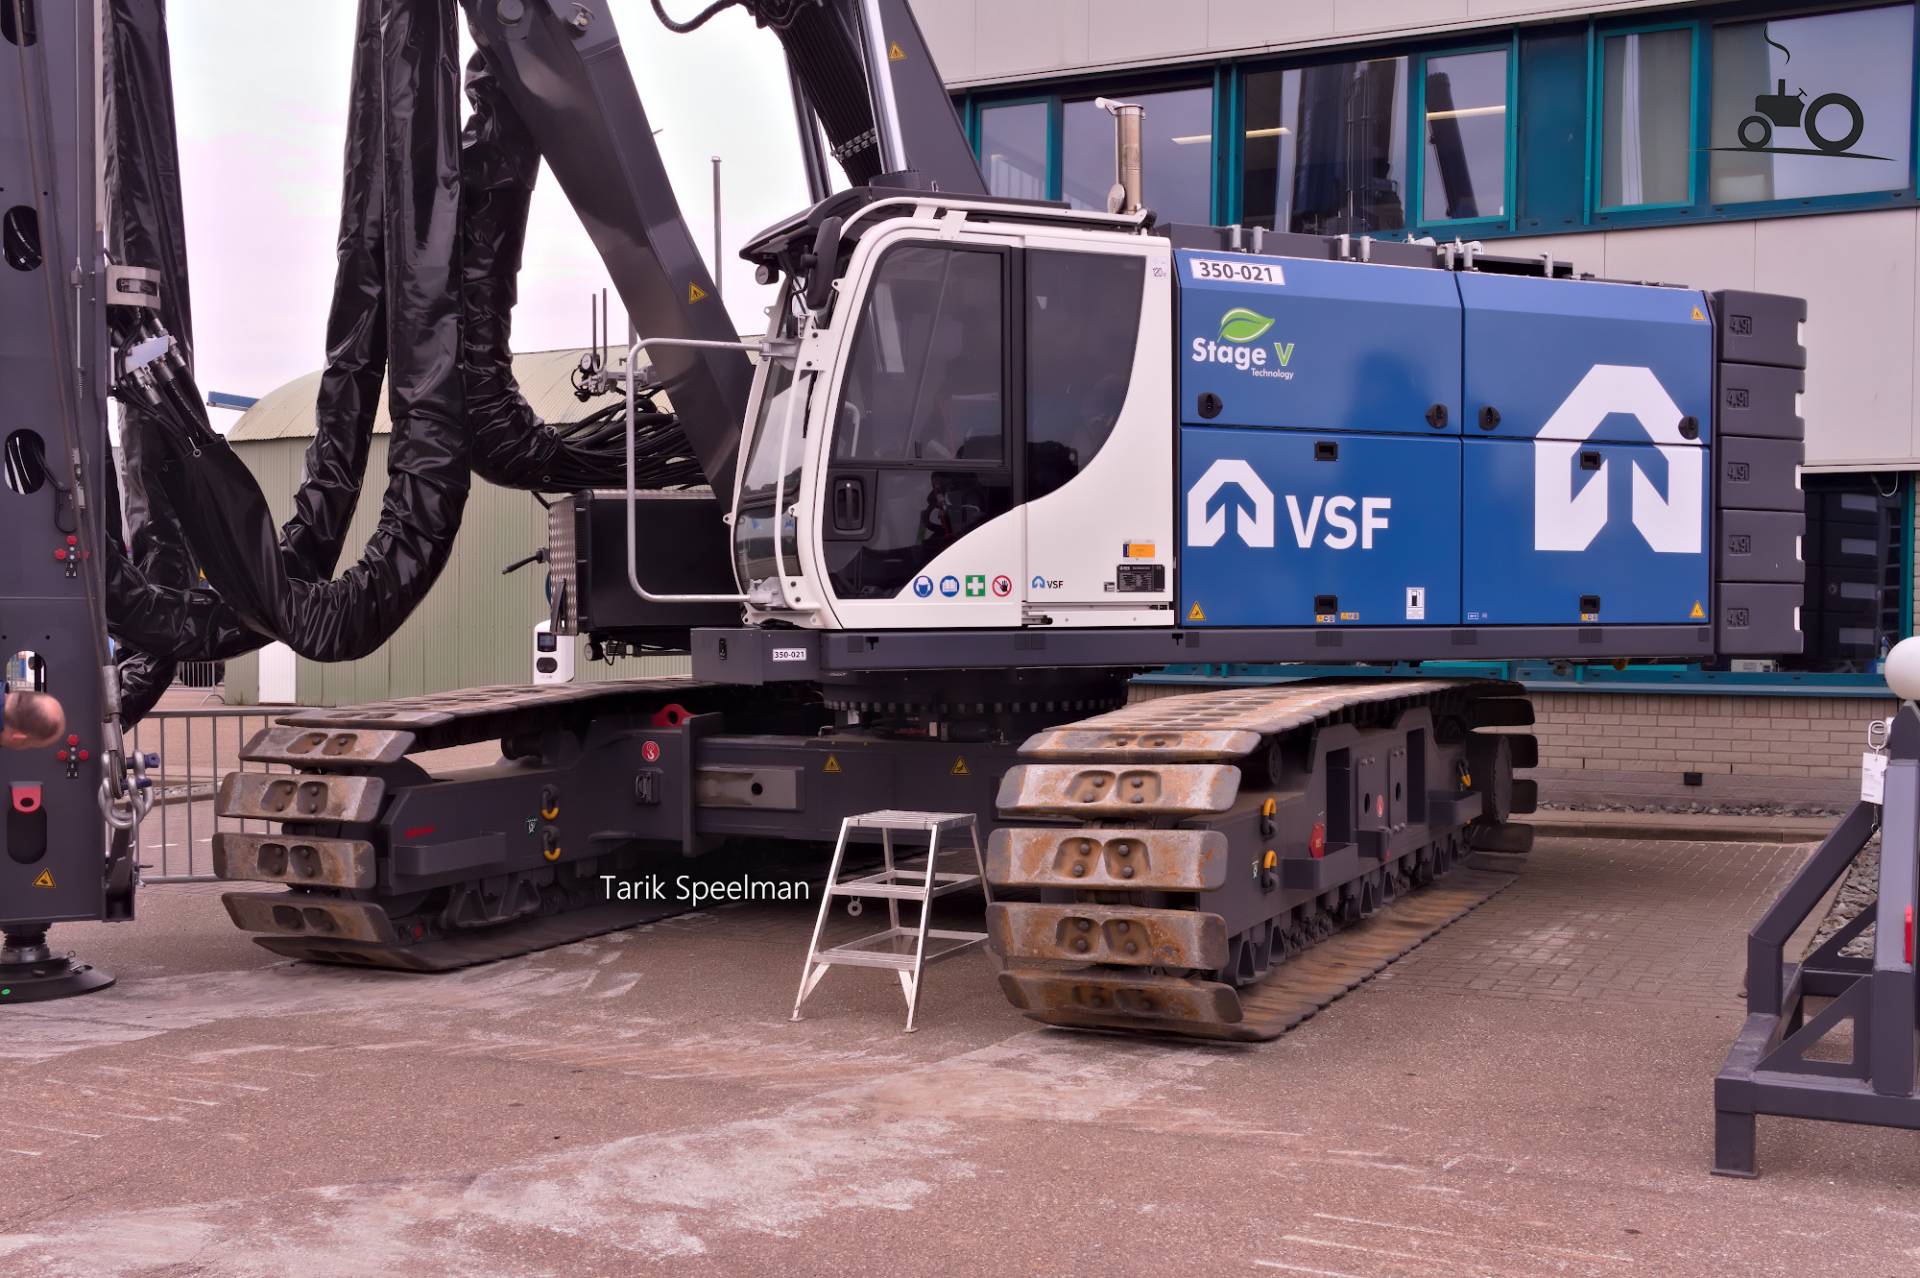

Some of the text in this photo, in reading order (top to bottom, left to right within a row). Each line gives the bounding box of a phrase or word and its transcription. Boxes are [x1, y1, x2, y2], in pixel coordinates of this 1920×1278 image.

[1199, 261, 1274, 282] 350-021
[1192, 337, 1295, 371] Stage V
[1251, 367, 1294, 380] Technology
[1285, 495, 1391, 550] VSF
[1046, 580, 1064, 589] VSF
[774, 651, 805, 659] 350-021
